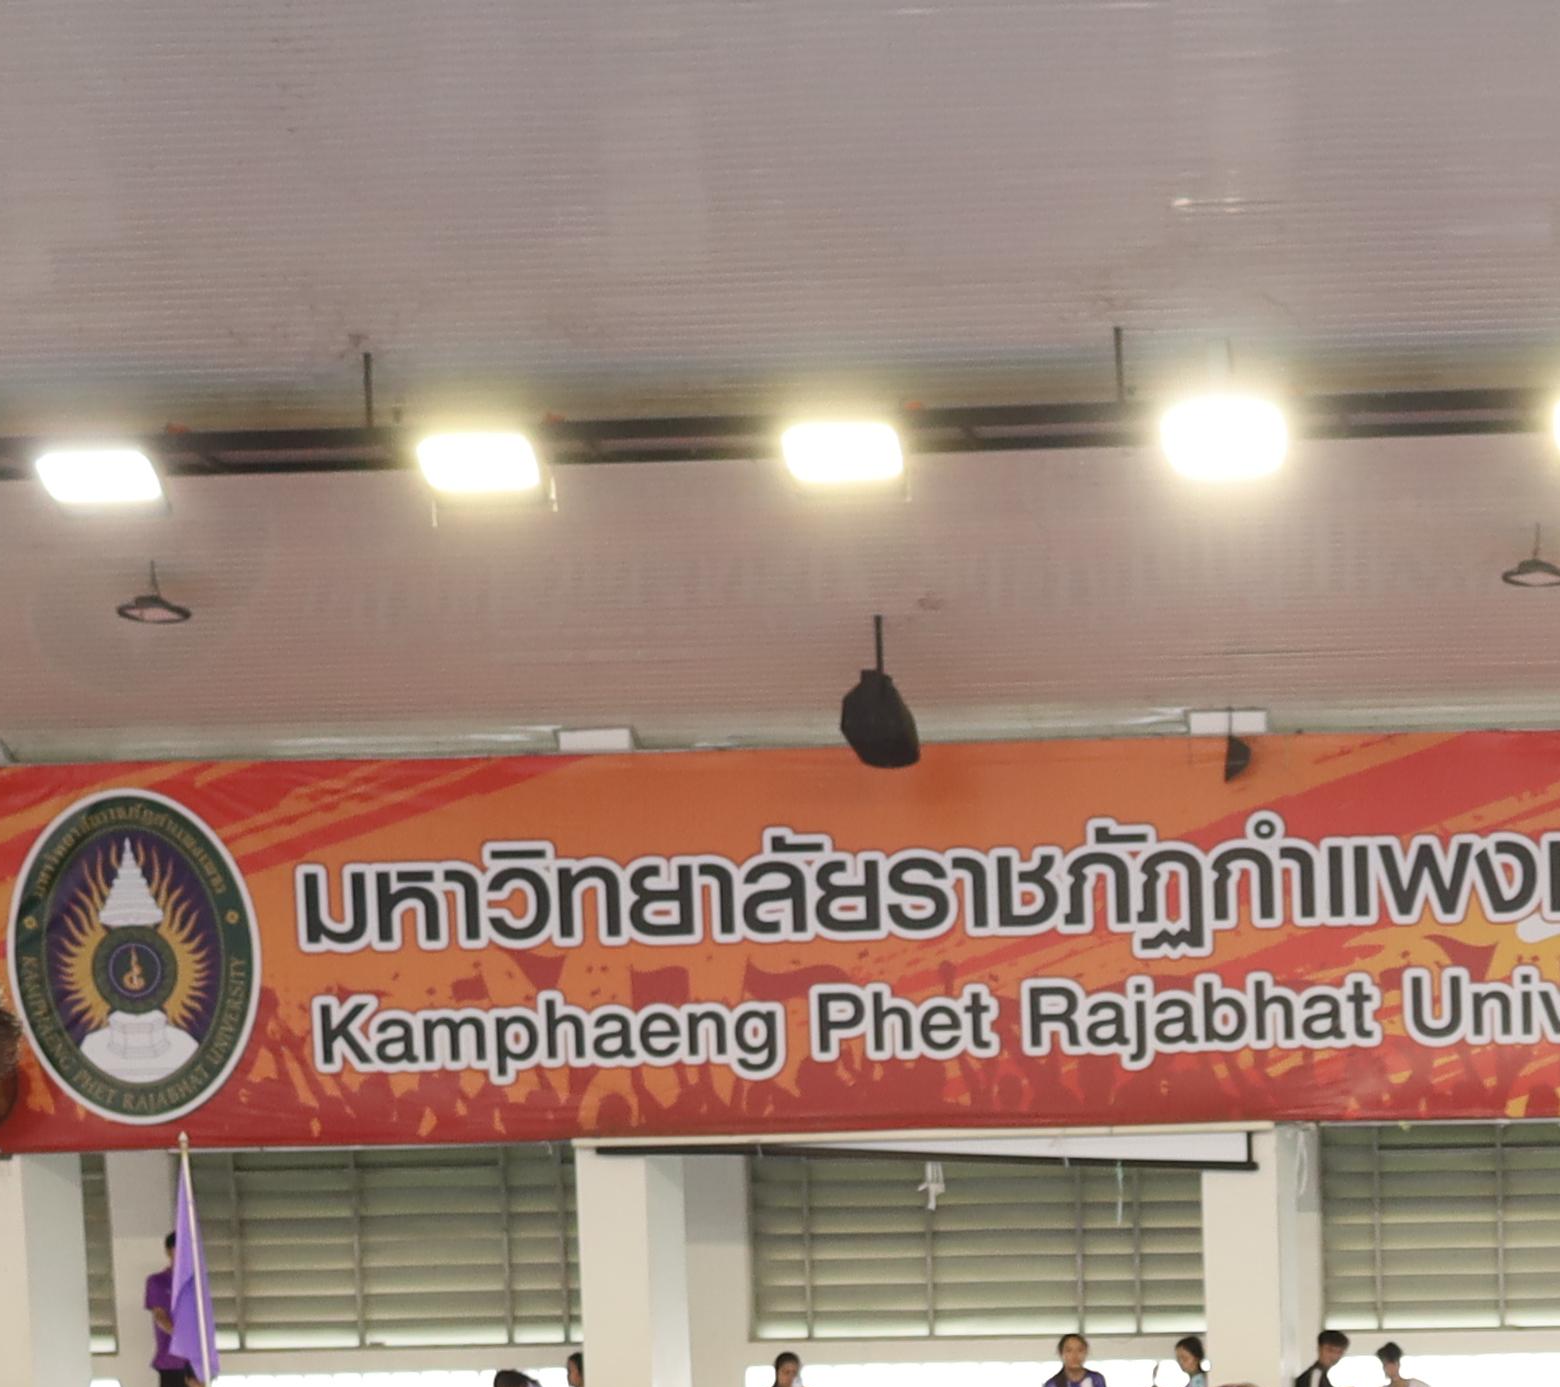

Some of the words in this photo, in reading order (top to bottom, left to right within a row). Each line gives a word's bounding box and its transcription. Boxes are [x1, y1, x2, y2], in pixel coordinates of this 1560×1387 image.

[316, 994, 780, 1079] Kamphaeng
[815, 989, 994, 1055] Phet
[1027, 978, 1378, 1063] Rajabhat
